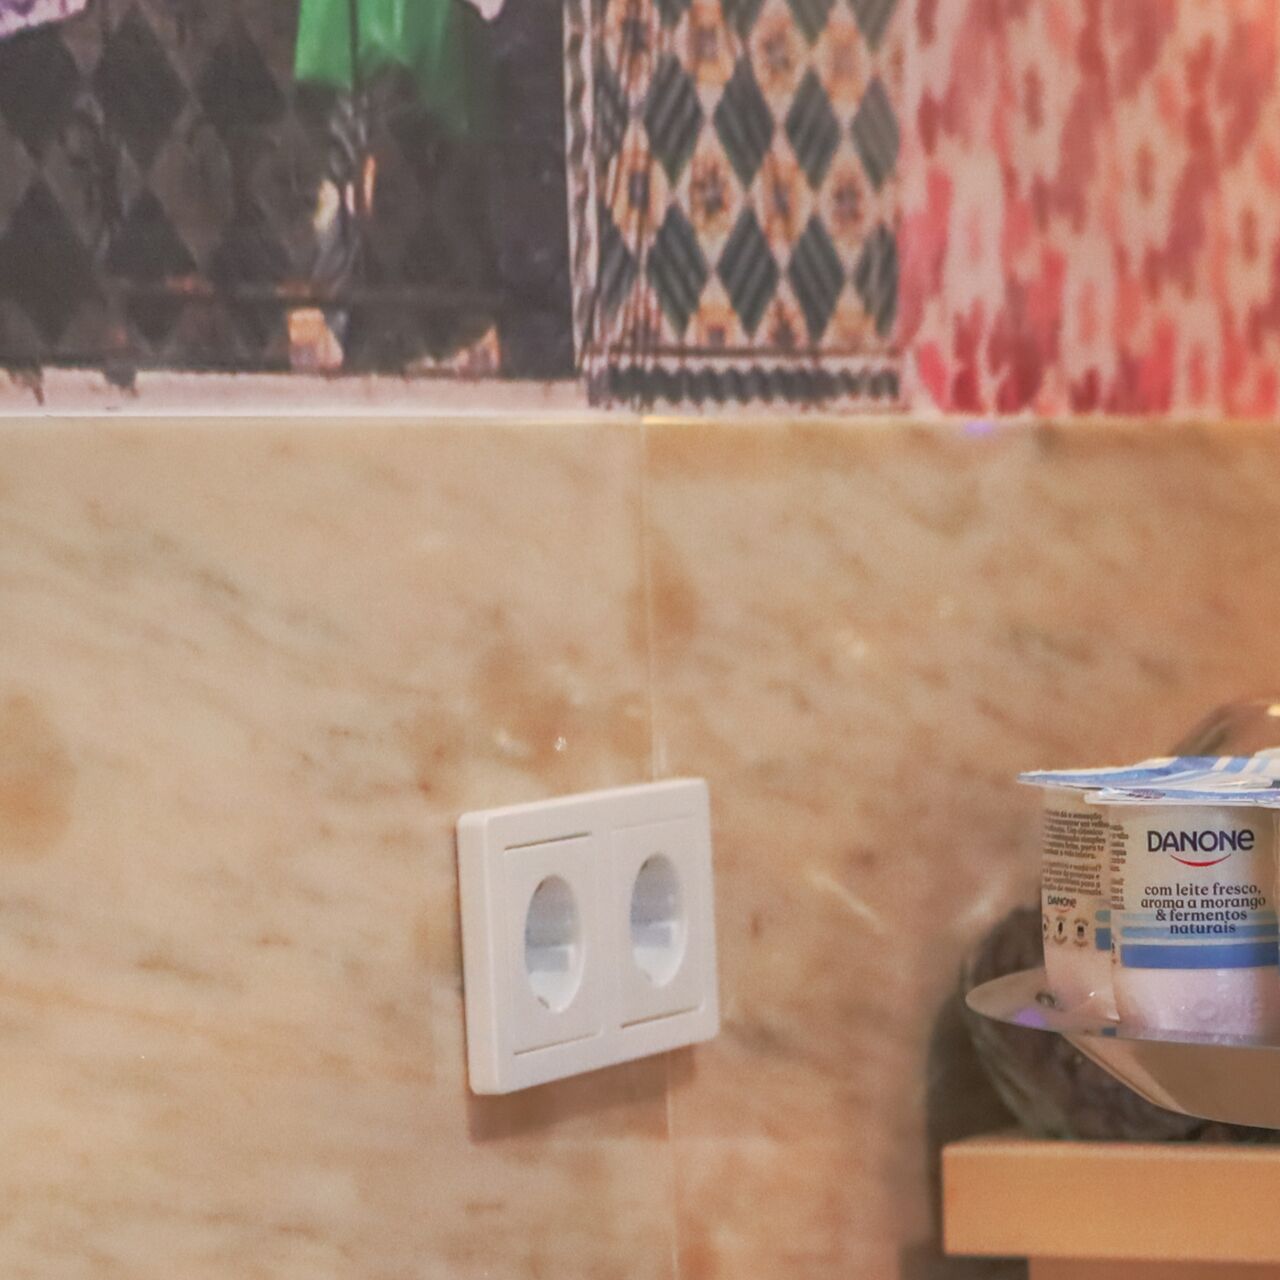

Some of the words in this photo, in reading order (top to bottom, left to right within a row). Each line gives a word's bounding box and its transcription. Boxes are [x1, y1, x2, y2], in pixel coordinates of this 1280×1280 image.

[1144, 885, 1173, 896] com
[1176, 883, 1209, 896] leite
[1212, 882, 1261, 896] fresco,
[1140, 898, 1184, 909] aroma
[1187, 898, 1197, 909] a
[1200, 896, 1266, 910] morango
[1155, 909, 1167, 922] &
[1169, 908, 1248, 922] fermentos
[1169, 921, 1236, 934] naturais
